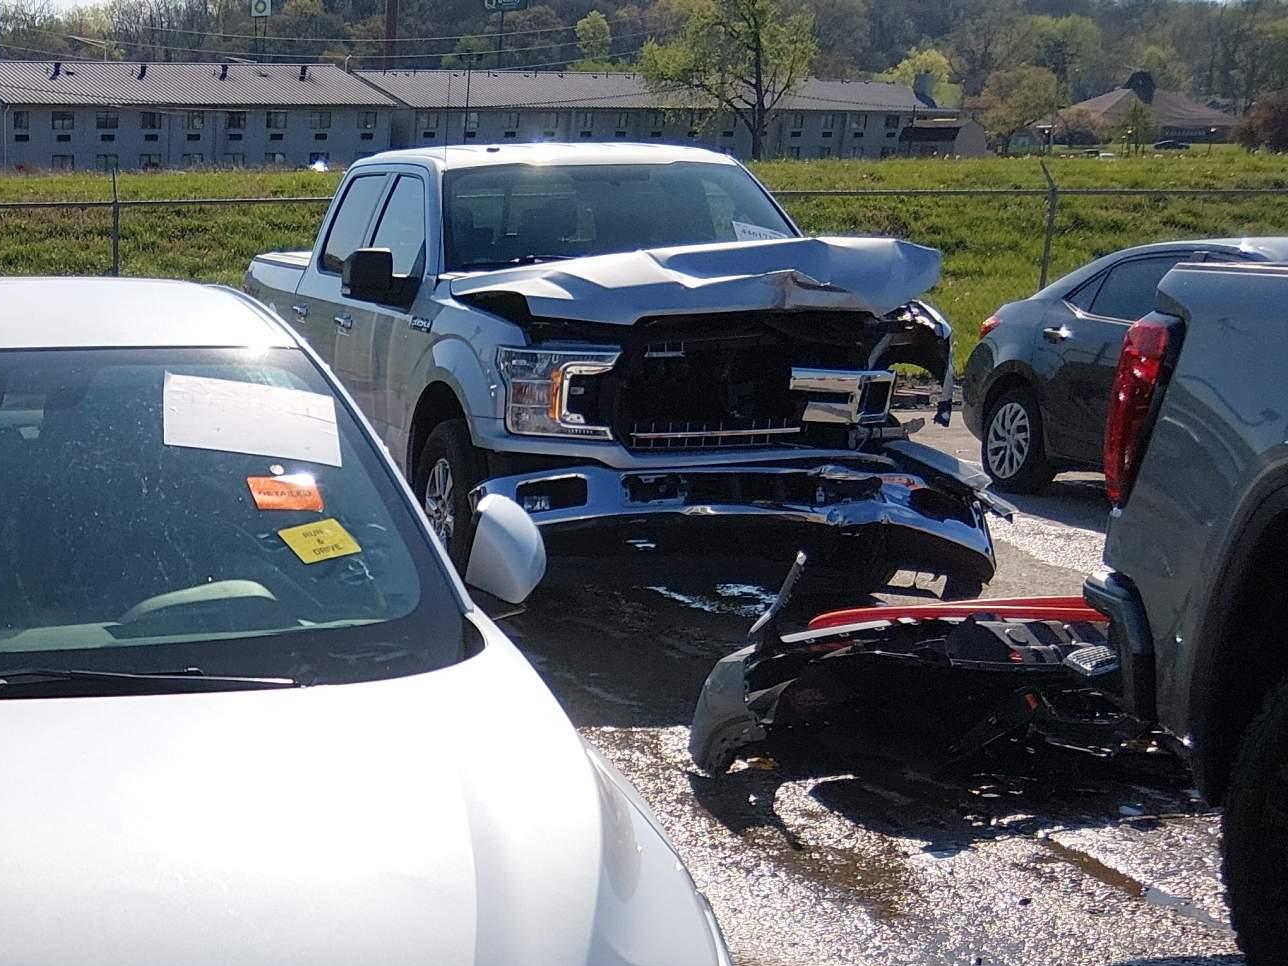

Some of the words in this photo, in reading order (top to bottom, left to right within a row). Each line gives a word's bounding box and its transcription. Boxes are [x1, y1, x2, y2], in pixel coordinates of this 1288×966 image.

[258, 488, 312, 497] DETAILED
[302, 528, 324, 538] RUN
[313, 543, 344, 556] DRIVE
